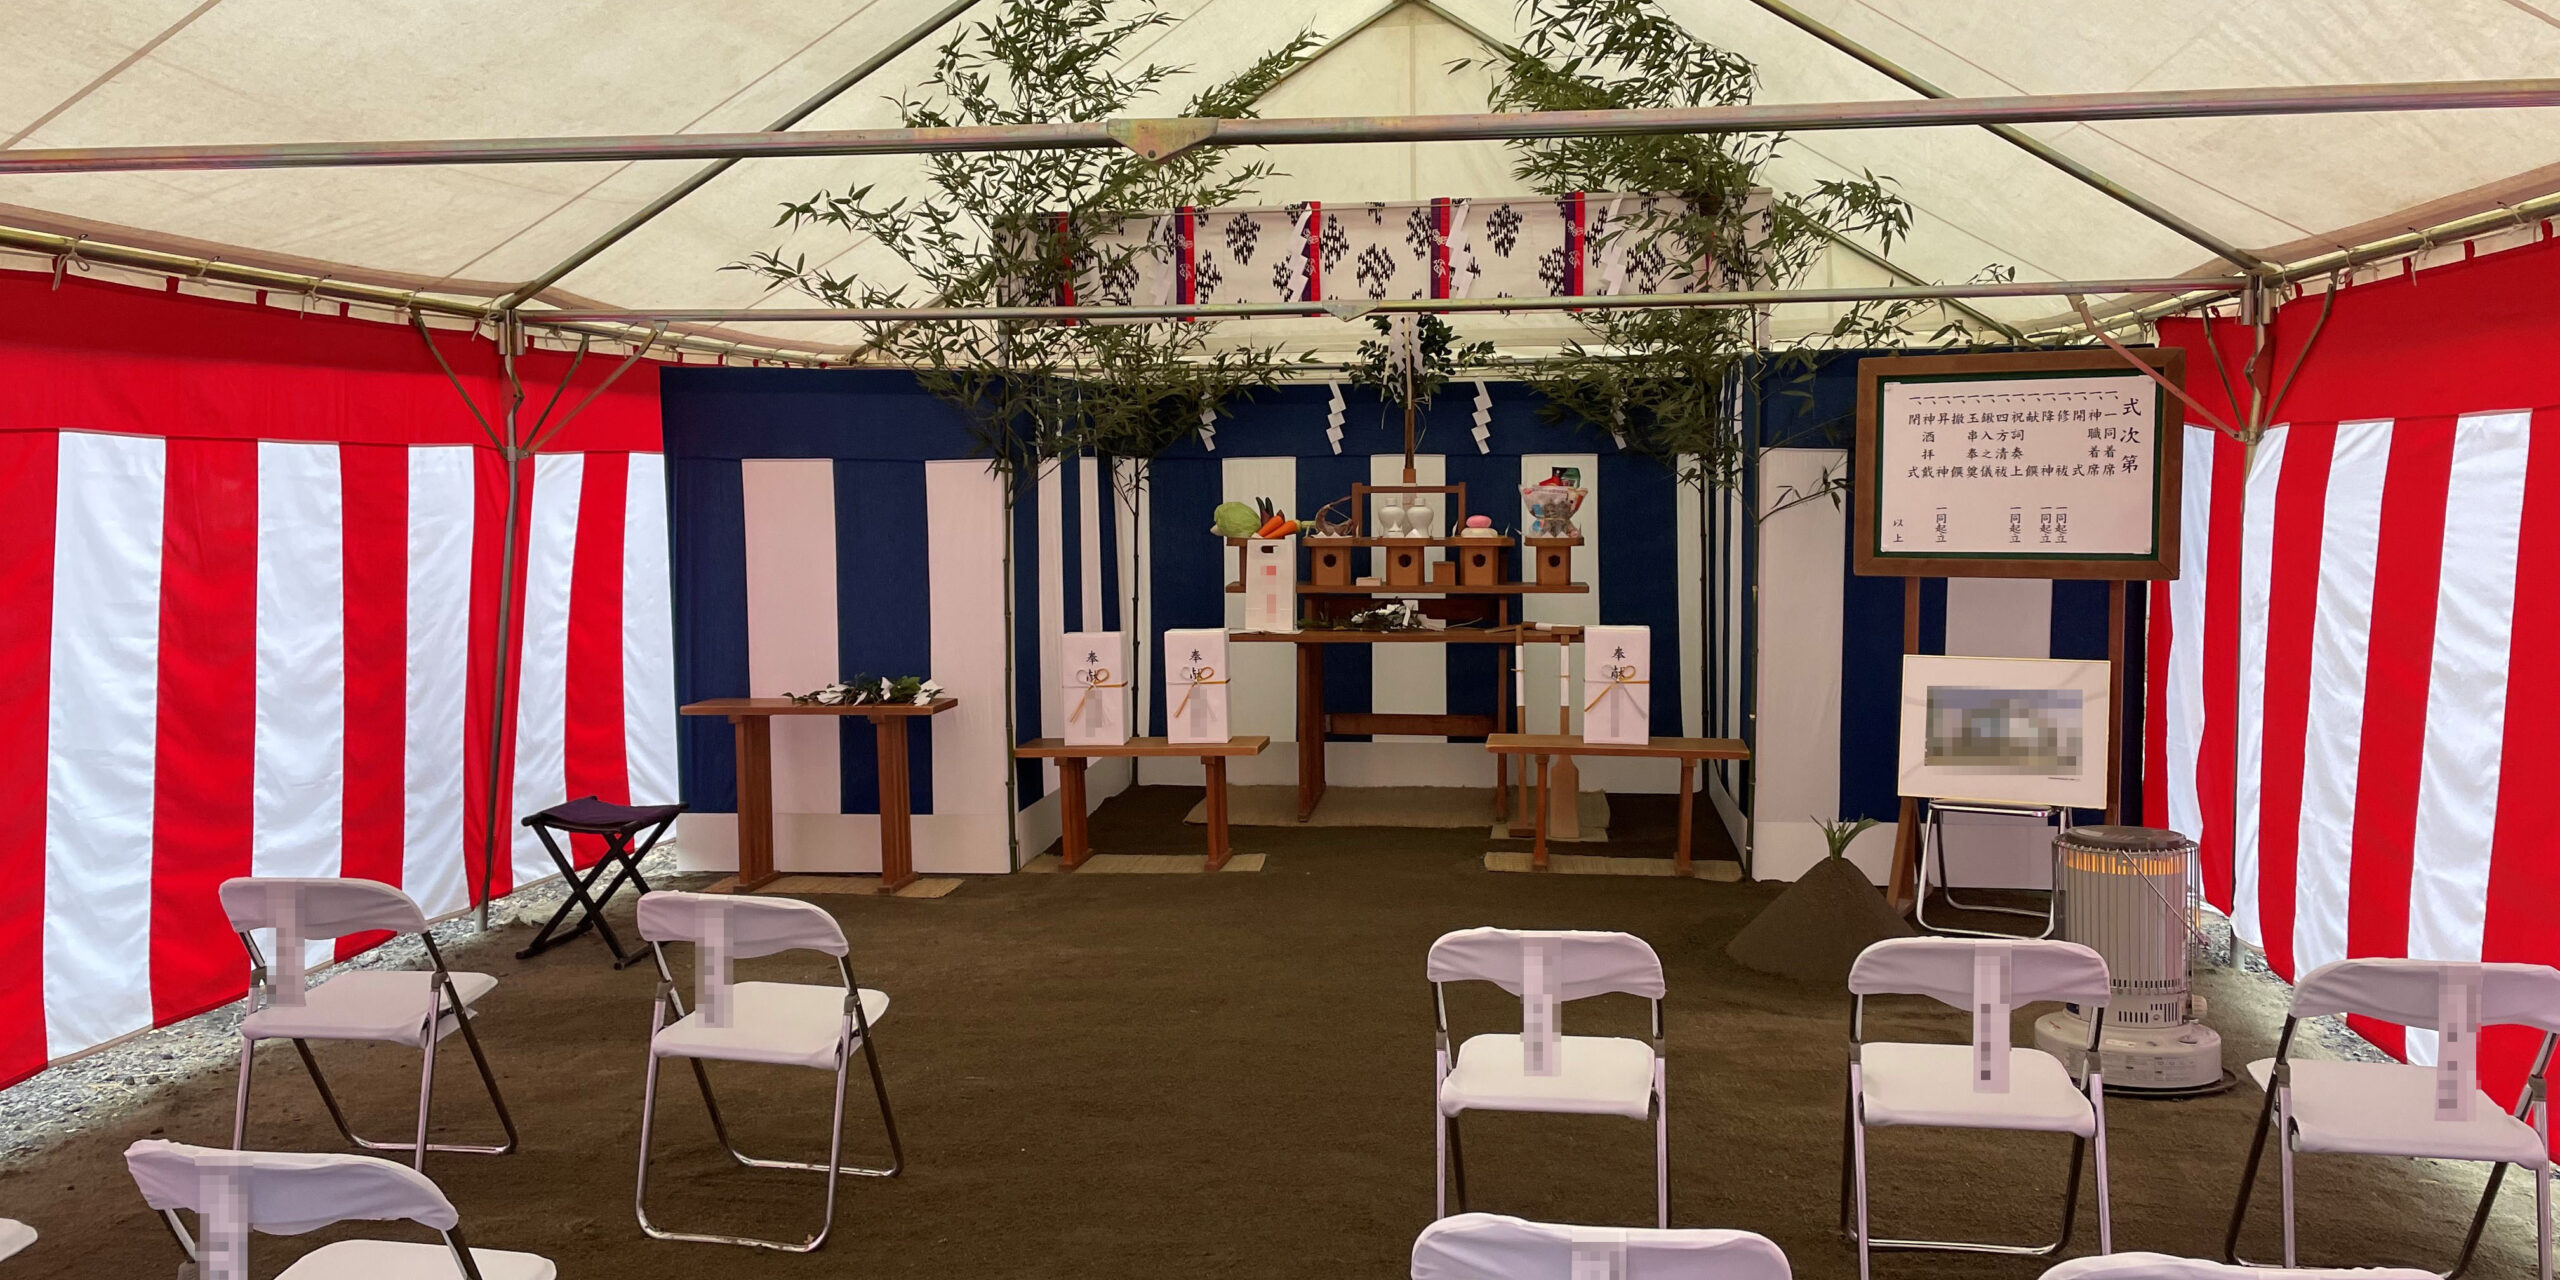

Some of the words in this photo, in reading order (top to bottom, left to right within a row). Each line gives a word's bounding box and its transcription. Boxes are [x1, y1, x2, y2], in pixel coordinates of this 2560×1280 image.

[2120, 397, 2141, 474] 式次第
[1892, 518, 1904, 543] 以上
[1935, 506, 1948, 543] 一同起立
[2009, 506, 2022, 544] 一同起立
[2040, 506, 2053, 544] 一同起立
[2055, 506, 2068, 544] 一同起立
